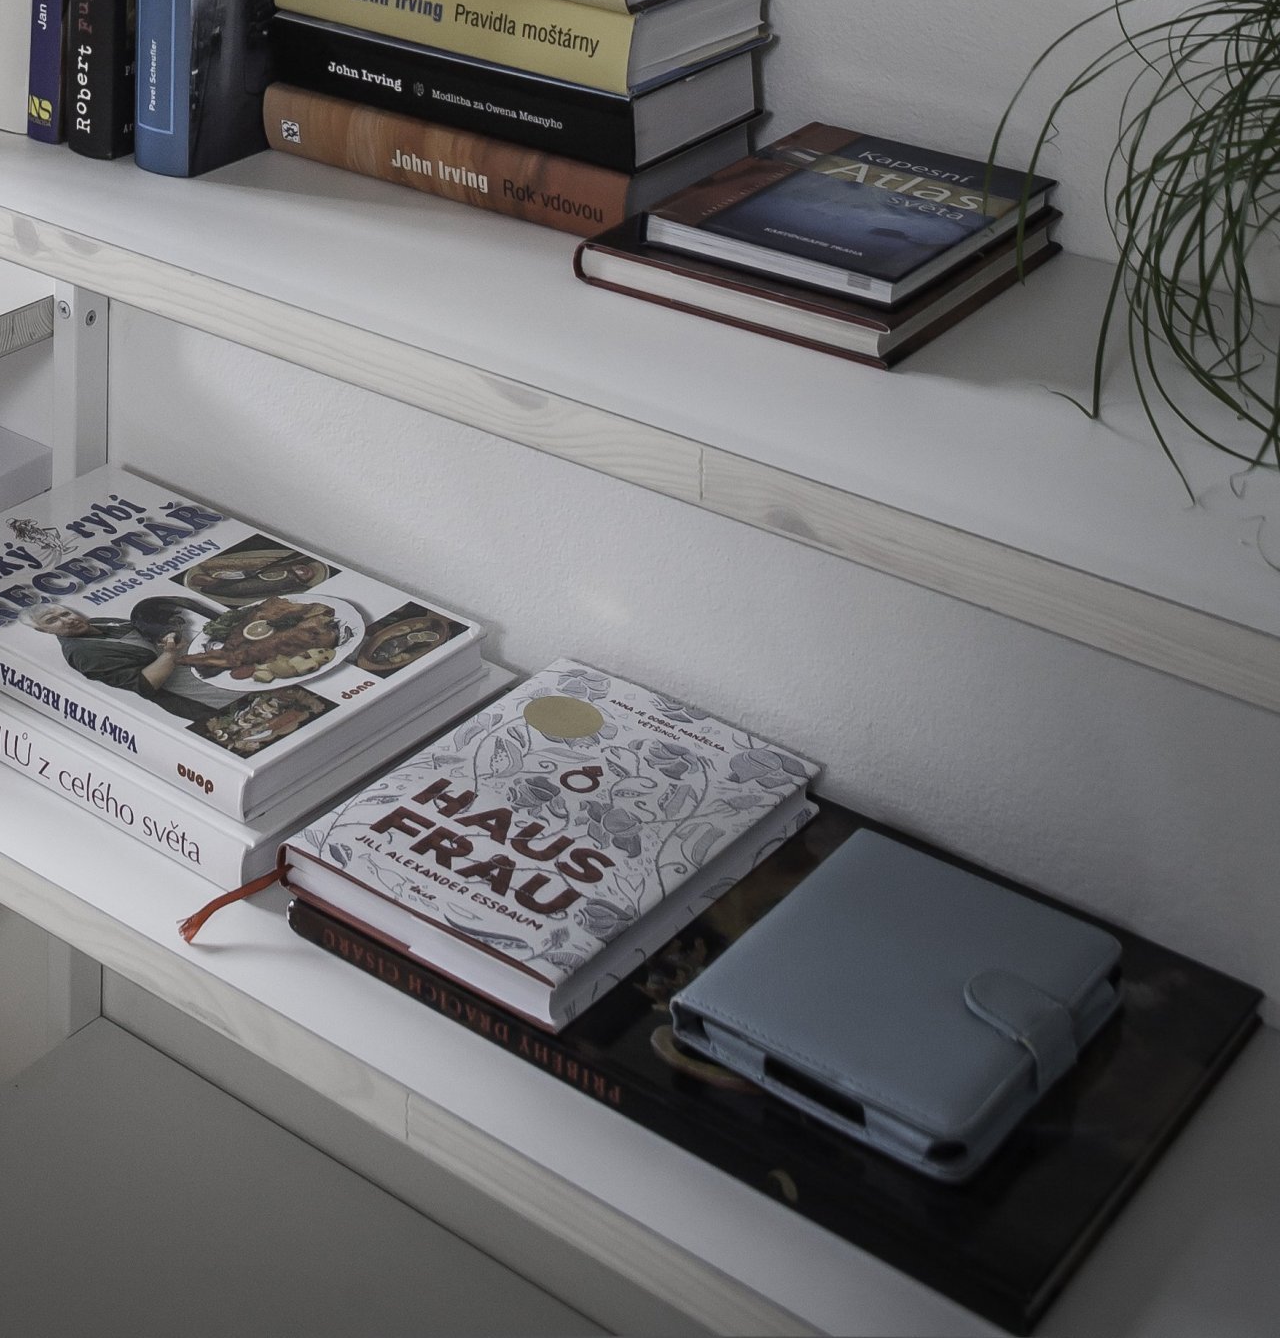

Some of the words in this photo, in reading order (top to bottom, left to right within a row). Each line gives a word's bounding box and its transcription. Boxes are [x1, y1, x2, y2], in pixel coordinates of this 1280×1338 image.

[37, 3, 48, 30] Jan
[455, 3, 516, 37] Pravidla
[522, 21, 599, 58] moštárny
[148, 39, 158, 84] Scheufler
[75, 44, 93, 133] Robert
[148, 86, 157, 112] Pavel
[328, 60, 359, 80] John
[362, 68, 402, 92] Irving
[431, 89, 472, 108] Modlitba
[472, 100, 485, 111] za
[485, 102, 518, 119] Owena
[518, 109, 563, 130] Meanyho
[391, 148, 433, 177] John
[438, 159, 489, 195] Irving
[501, 178, 536, 205] Rok
[540, 190, 604, 224] vdovou
[821, 163, 984, 212] Atlas
[857, 150, 975, 185] Kapesní
[888, 195, 965, 222] světa
[66, 494, 148, 540] rybí
[83, 569, 142, 607] Miloše
[138, 536, 221, 581] Štěpničky
[341, 680, 376, 700] dona
[62, 697, 97, 732] RYBÍ
[97, 714, 138, 755] Velký
[609, 699, 635, 713] ANNA
[634, 709, 647, 717] JE
[647, 714, 683, 731] DOBRÁ
[176, 762, 215, 796] dona
[37, 756, 51, 780] z
[58, 772, 135, 827] celého
[142, 814, 203, 866] světa
[411, 777, 617, 884] HAUS
[355, 833, 384, 854] JILL
[385, 850, 470, 896] ALEXANDER
[470, 892, 544, 932] ESSBAUM
[369, 805, 584, 915] FRAU
